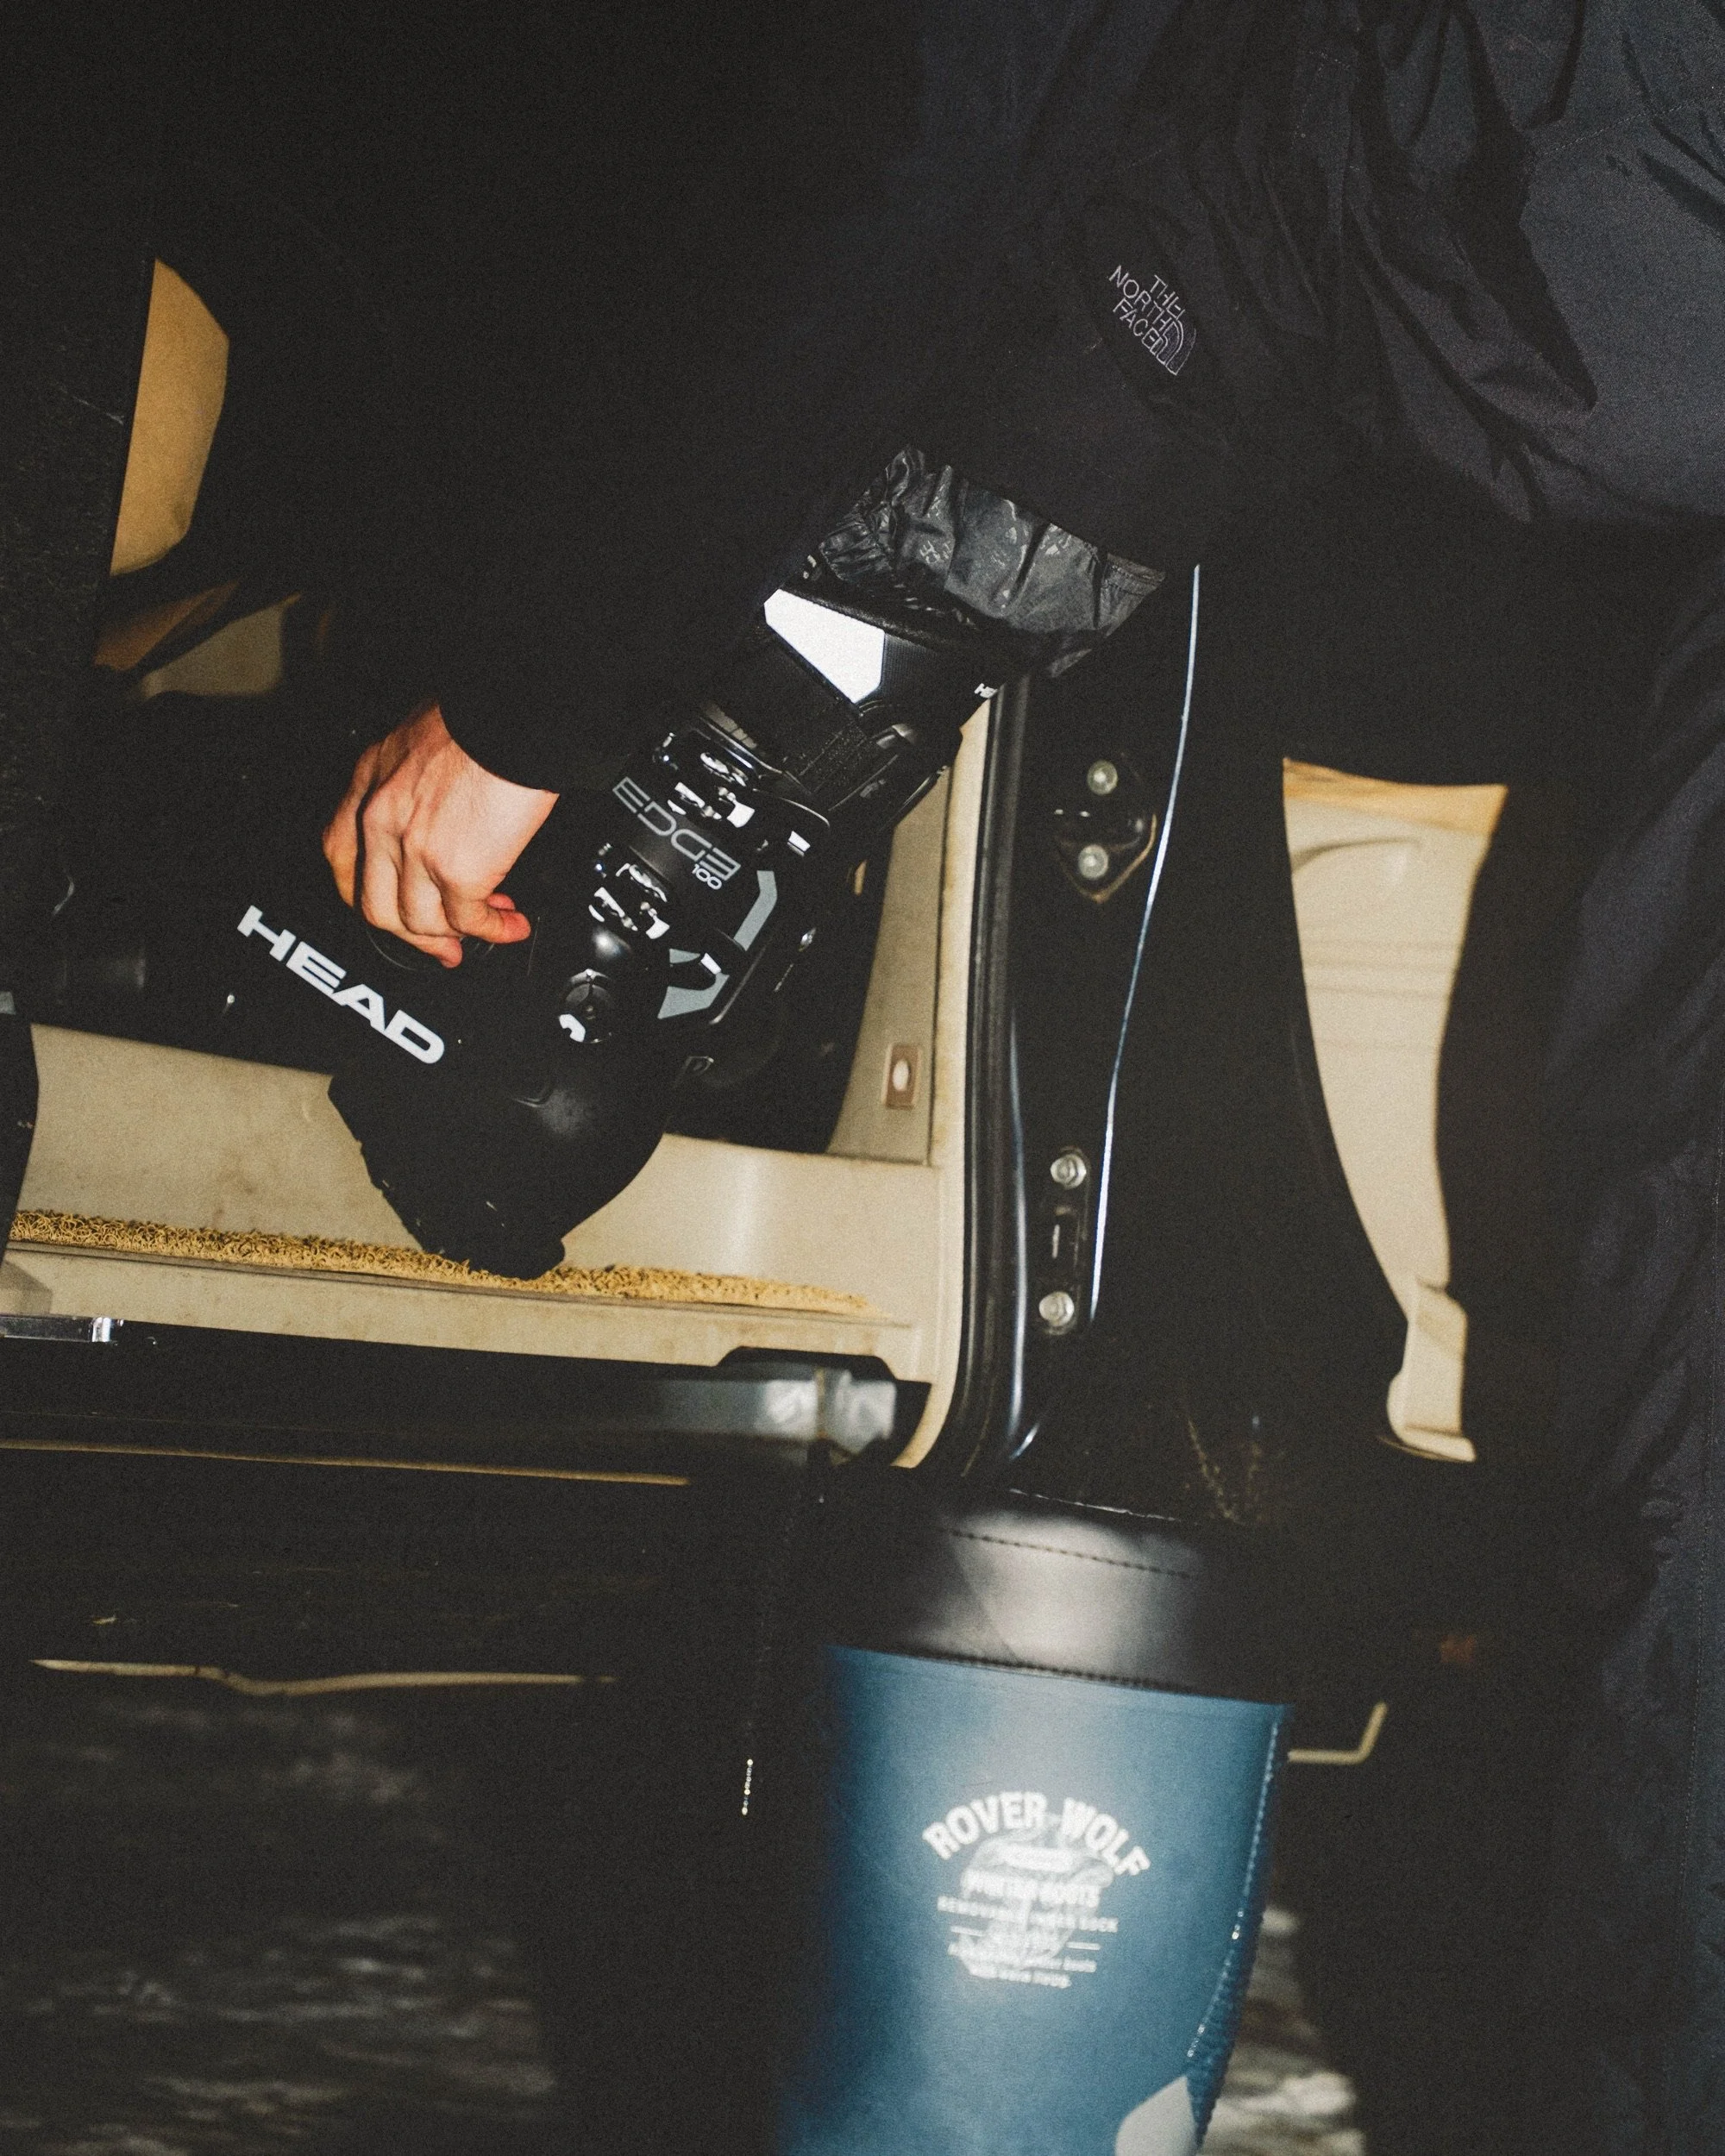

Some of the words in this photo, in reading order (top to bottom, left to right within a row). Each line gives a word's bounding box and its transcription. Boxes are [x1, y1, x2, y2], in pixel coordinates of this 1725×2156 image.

[1108, 265, 1172, 332] NORTH
[1113, 298, 1160, 350] FACE
[1150, 274, 1185, 320] THE
[612, 777, 741, 881] EDGE
[692, 864, 722, 890] 100
[236, 905, 444, 1063] HEAD
[922, 1791, 1048, 1860] ROVER
[1060, 1797, 1151, 1876] WOLF
